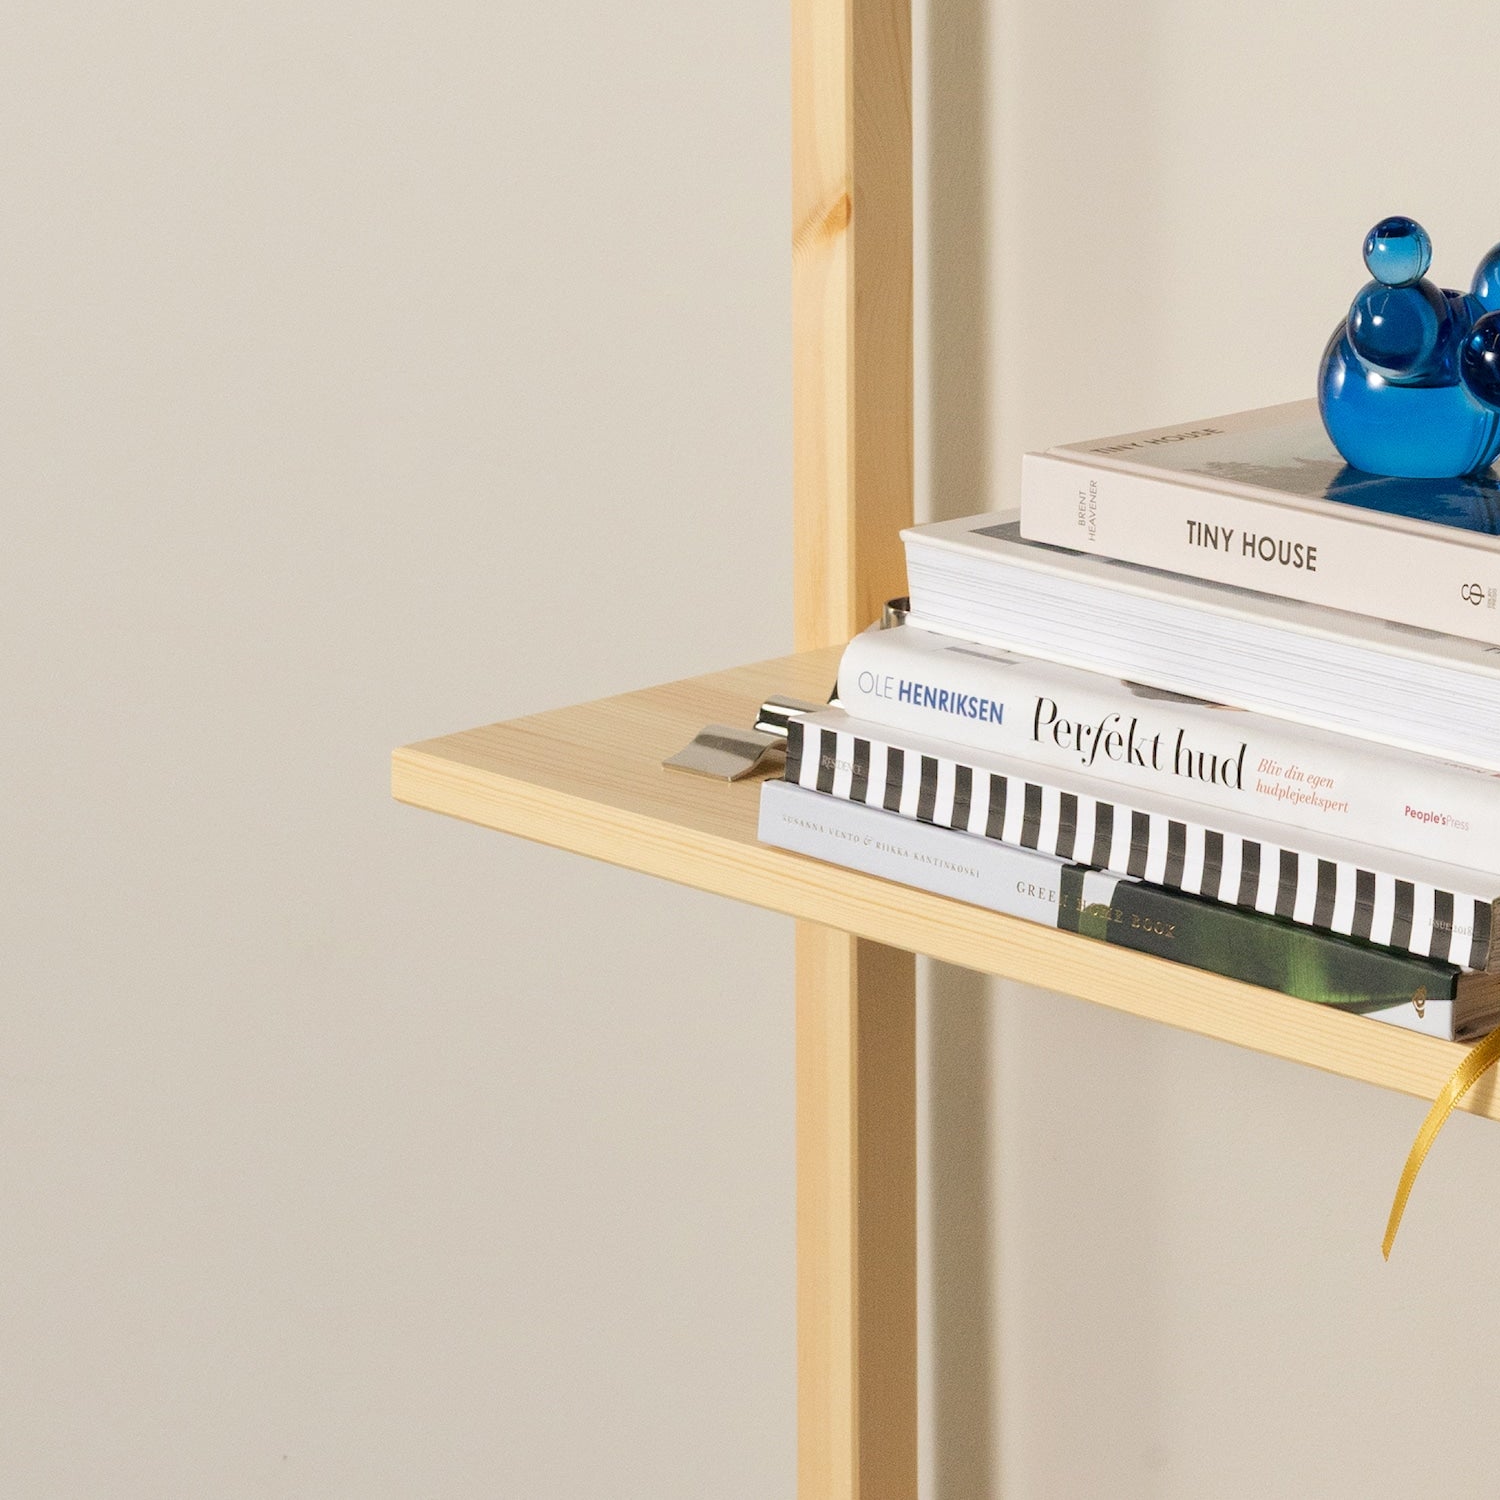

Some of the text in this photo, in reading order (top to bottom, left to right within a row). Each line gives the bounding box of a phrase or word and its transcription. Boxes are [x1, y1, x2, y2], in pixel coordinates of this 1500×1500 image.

[1089, 428, 1225, 455] TINY HOUSE
[1077, 490, 1087, 527] BRENT
[1088, 479, 1098, 542] HEAVENER
[1187, 520, 1317, 572] TINY HOUSE
[858, 671, 1247, 791] OLE HENRIKSEN Perfekt hud
[1257, 758, 1335, 789] Bliv din egen
[1256, 779, 1350, 814] hudplejeekspert
[782, 815, 824, 833] SUSANNA
[829, 828, 860, 843] VENTO
[876, 841, 909, 858] RIIKKA
[913, 852, 981, 879] KANTINKOSKI
[1131, 913, 1175, 938] BOOK
[1453, 923, 1473, 937] 2018
